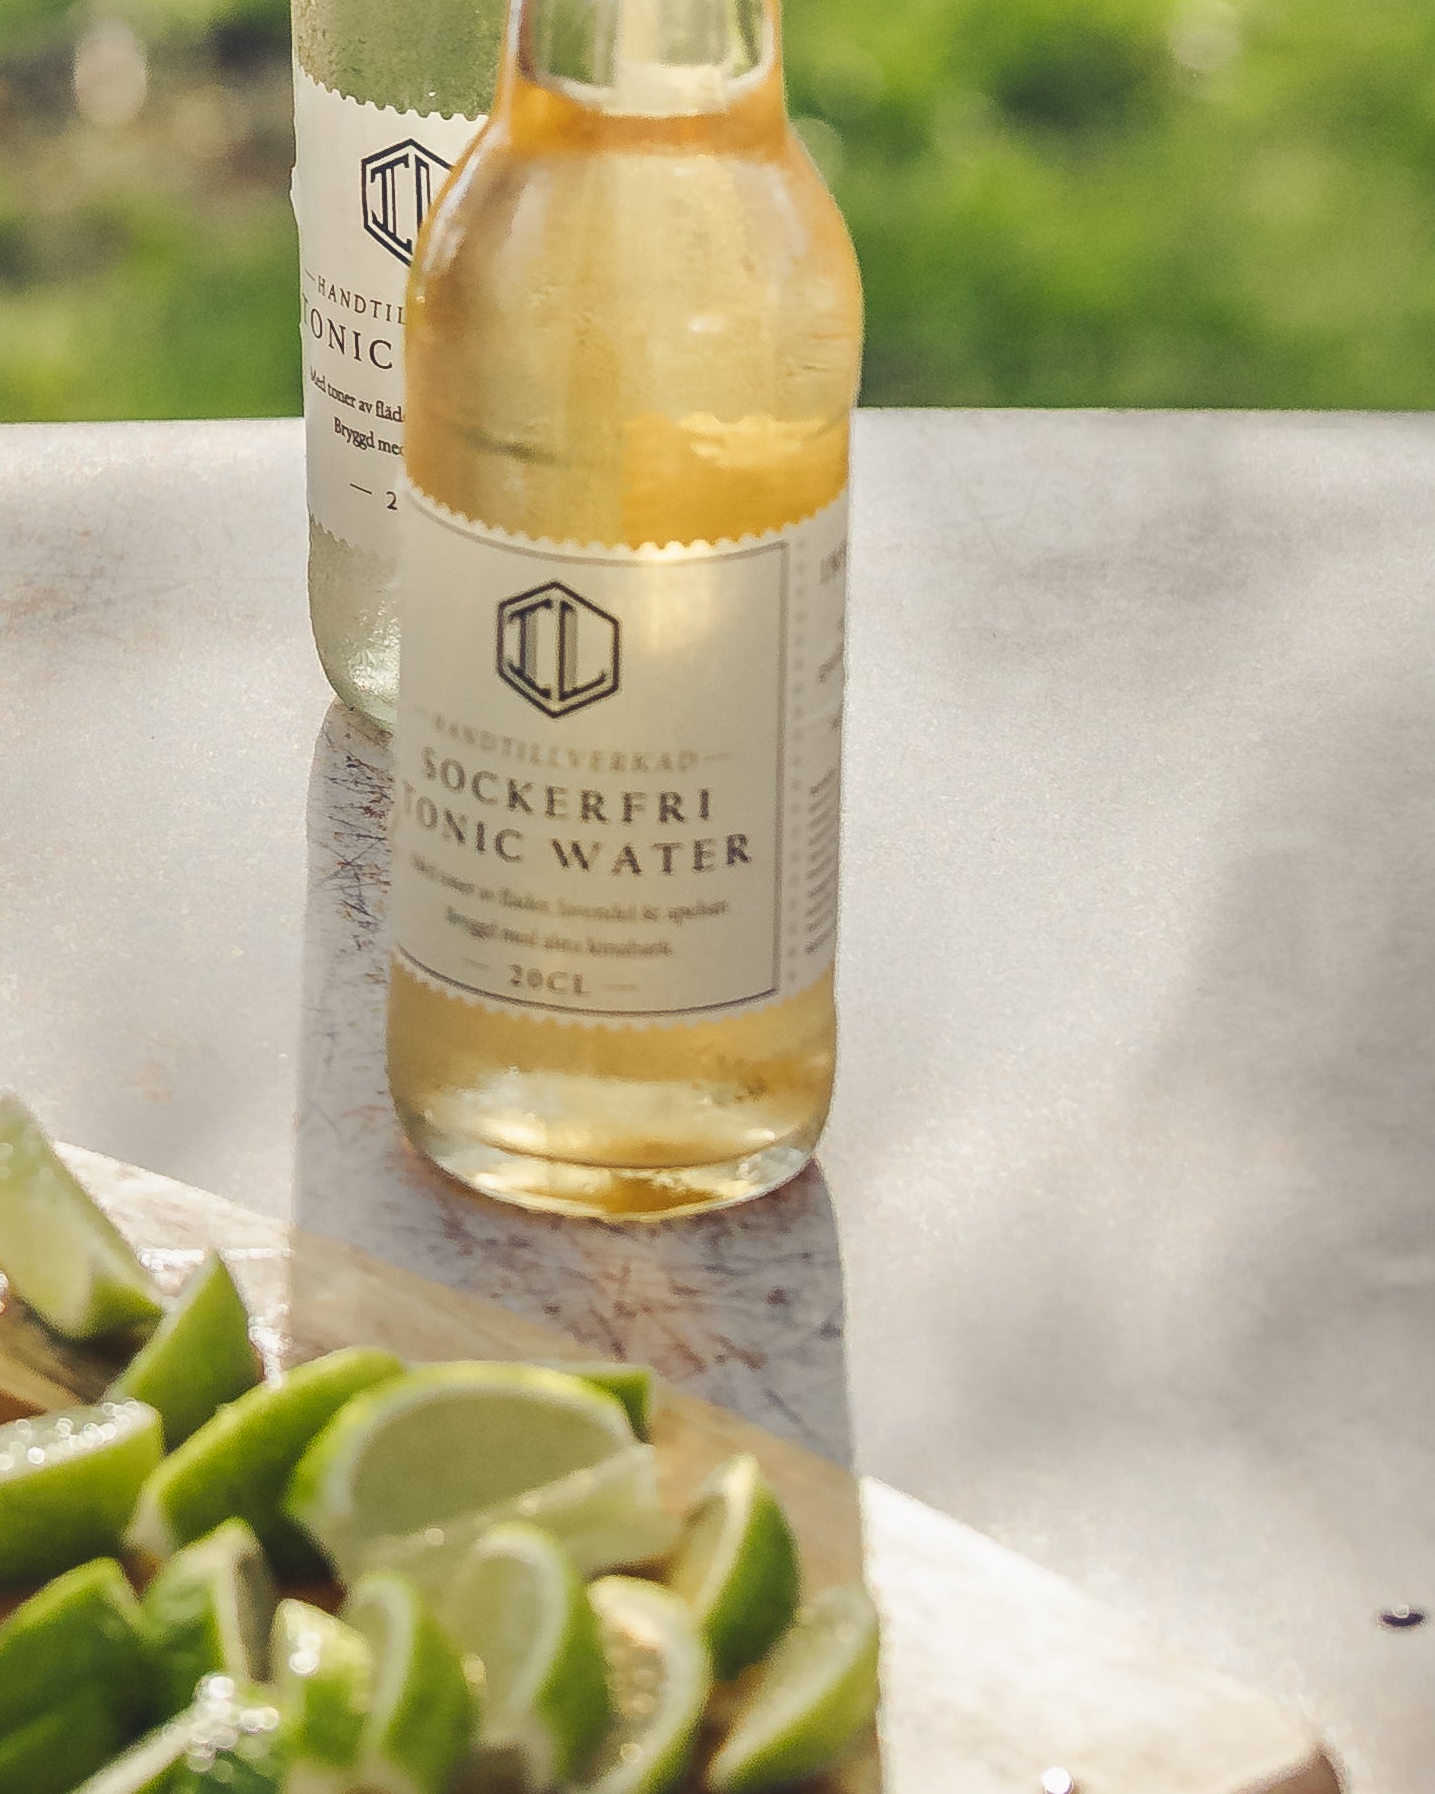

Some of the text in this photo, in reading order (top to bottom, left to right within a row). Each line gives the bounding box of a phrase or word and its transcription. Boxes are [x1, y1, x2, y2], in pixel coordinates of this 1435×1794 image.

[317, 275, 407, 325] HANDTIL
[327, 383, 356, 408] toner
[358, 399, 373, 414] av
[375, 400, 405, 423] fläd
[333, 416, 375, 451] Bryggd
[420, 745, 712, 825] SOCKERFRI
[402, 779, 752, 877] TONIC WATER
[508, 964, 590, 996] 20CL
